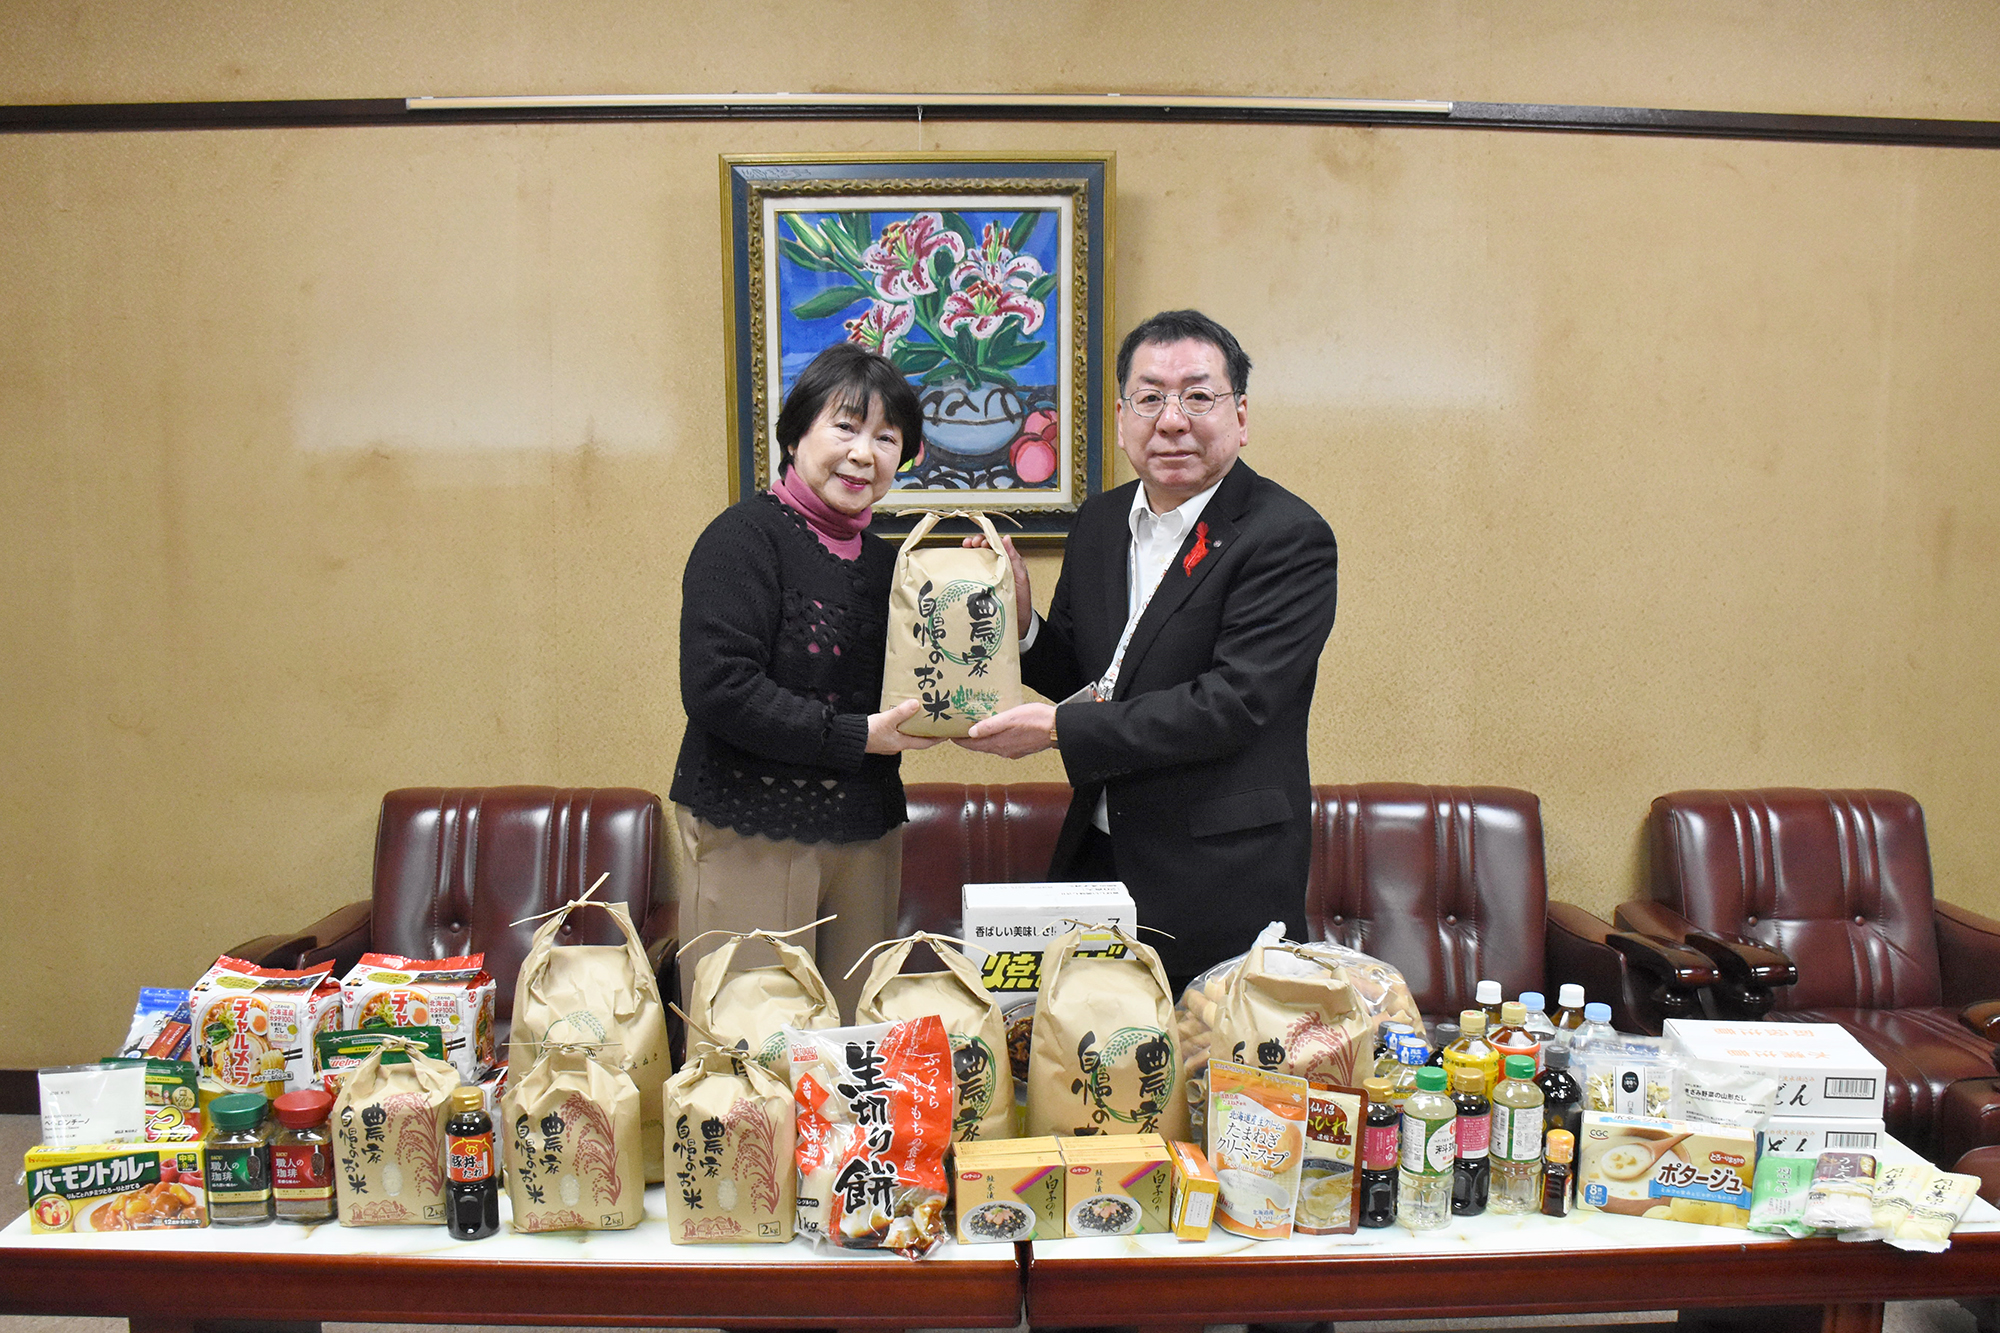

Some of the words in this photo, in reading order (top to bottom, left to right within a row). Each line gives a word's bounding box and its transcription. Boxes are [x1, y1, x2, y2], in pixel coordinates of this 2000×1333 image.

[966, 586, 1001, 678] 農家
[913, 579, 952, 722] 自慢のお米
[233, 998, 252, 1086] チャルメラ
[361, 1103, 387, 1164] 農家
[539, 1111, 566, 1175] 農家
[836, 1040, 899, 1216] 生切り餅
[1226, 1122, 1281, 1148] たまねぎ
[1308, 1115, 1350, 1136] ひれ
[1589, 1128, 1609, 1137] CGC
[178, 1154, 195, 1162] 中辛
[275, 1157, 304, 1168] 職人の
[338, 1105, 369, 1195] 自慢のお米
[515, 1113, 546, 1204] 自慢のお米
[673, 1114, 704, 1210] 自慢のお米
[699, 1116, 725, 1178] 農家
[1216, 1137, 1290, 1167] クリーミースープ
[33, 1156, 155, 1196] バーモントカレー
[210, 1161, 240, 1172] 職人の
[211, 1172, 233, 1181] 珈琲
[276, 1168, 298, 1178] 珈琲
[463, 1168, 483, 1179] たれ
[1658, 1162, 1741, 1192] ポタージュ
[1045, 1175, 1059, 1221] 白子のり
[1152, 1169, 1166, 1214] 白子のり
[604, 1216, 622, 1226] 2kg
[760, 1225, 779, 1235] 2kg
